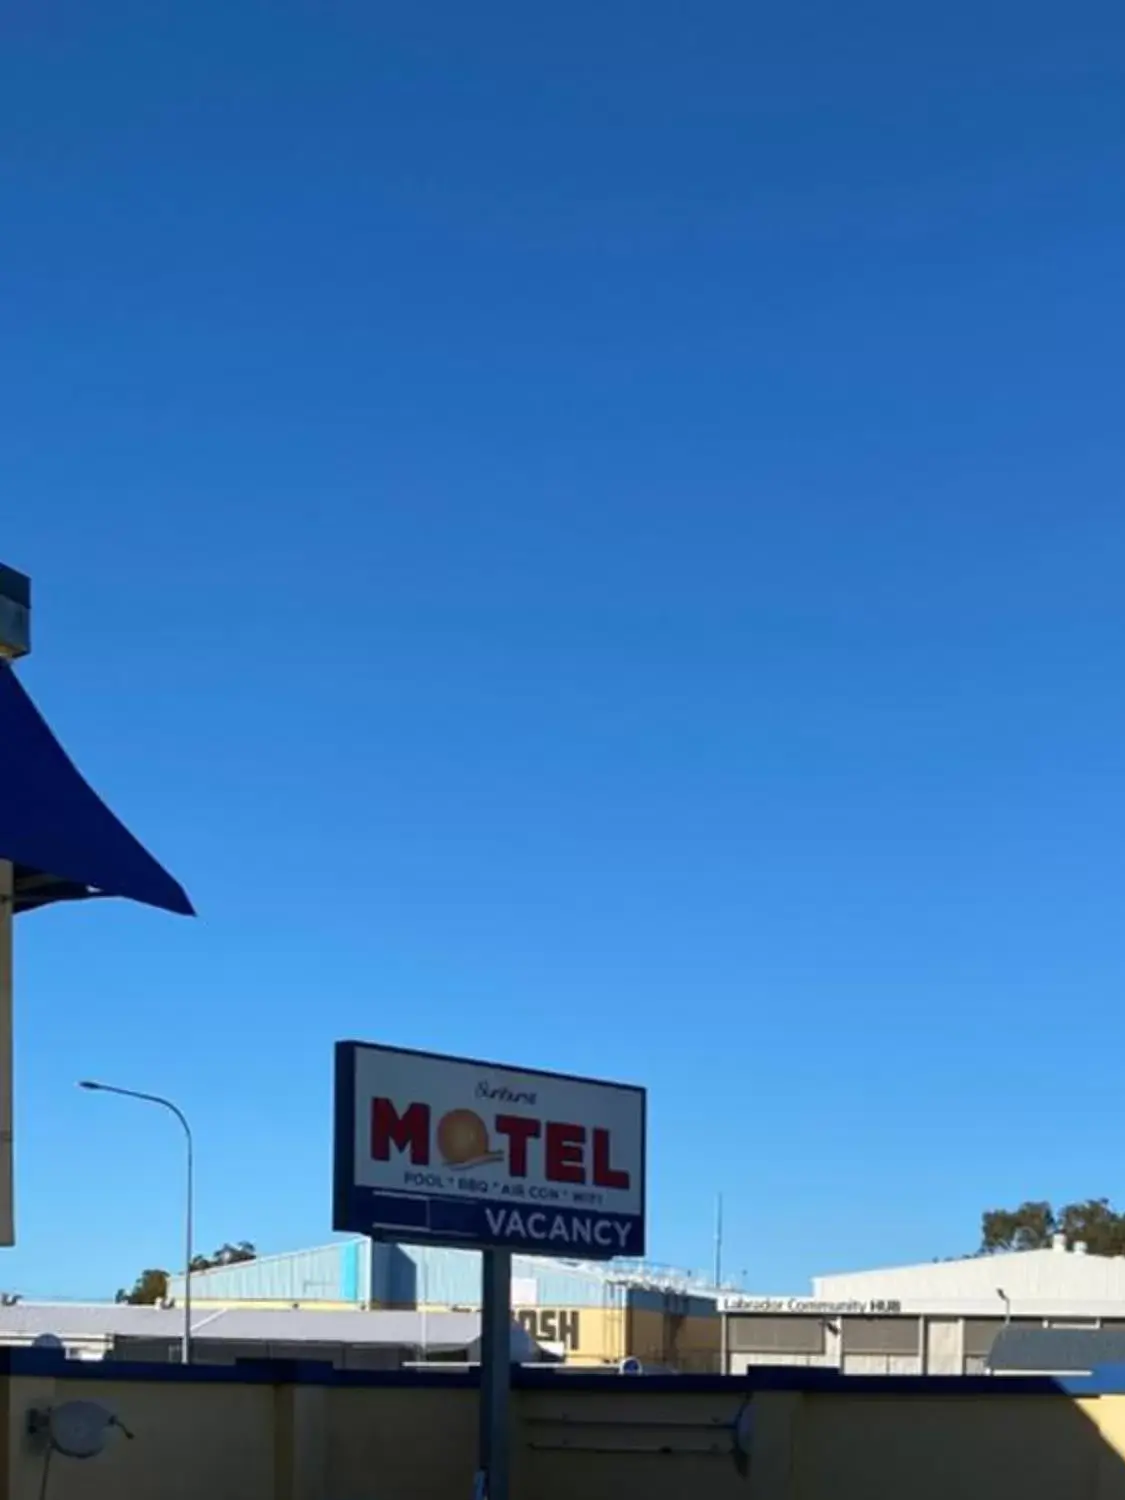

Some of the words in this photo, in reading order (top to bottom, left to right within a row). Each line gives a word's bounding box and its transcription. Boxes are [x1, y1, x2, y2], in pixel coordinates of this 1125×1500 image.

[371, 1097, 630, 1189] MOTEL
[404, 1171, 444, 1189] POOL
[458, 1178, 488, 1194] BBQ
[501, 1184, 526, 1198] AIR
[529, 1186, 560, 1200] CON
[485, 1207, 631, 1247] VACANCY
[723, 1297, 783, 1312] Labrador
[788, 1299, 867, 1313] Community
[870, 1300, 902, 1313] HUB
